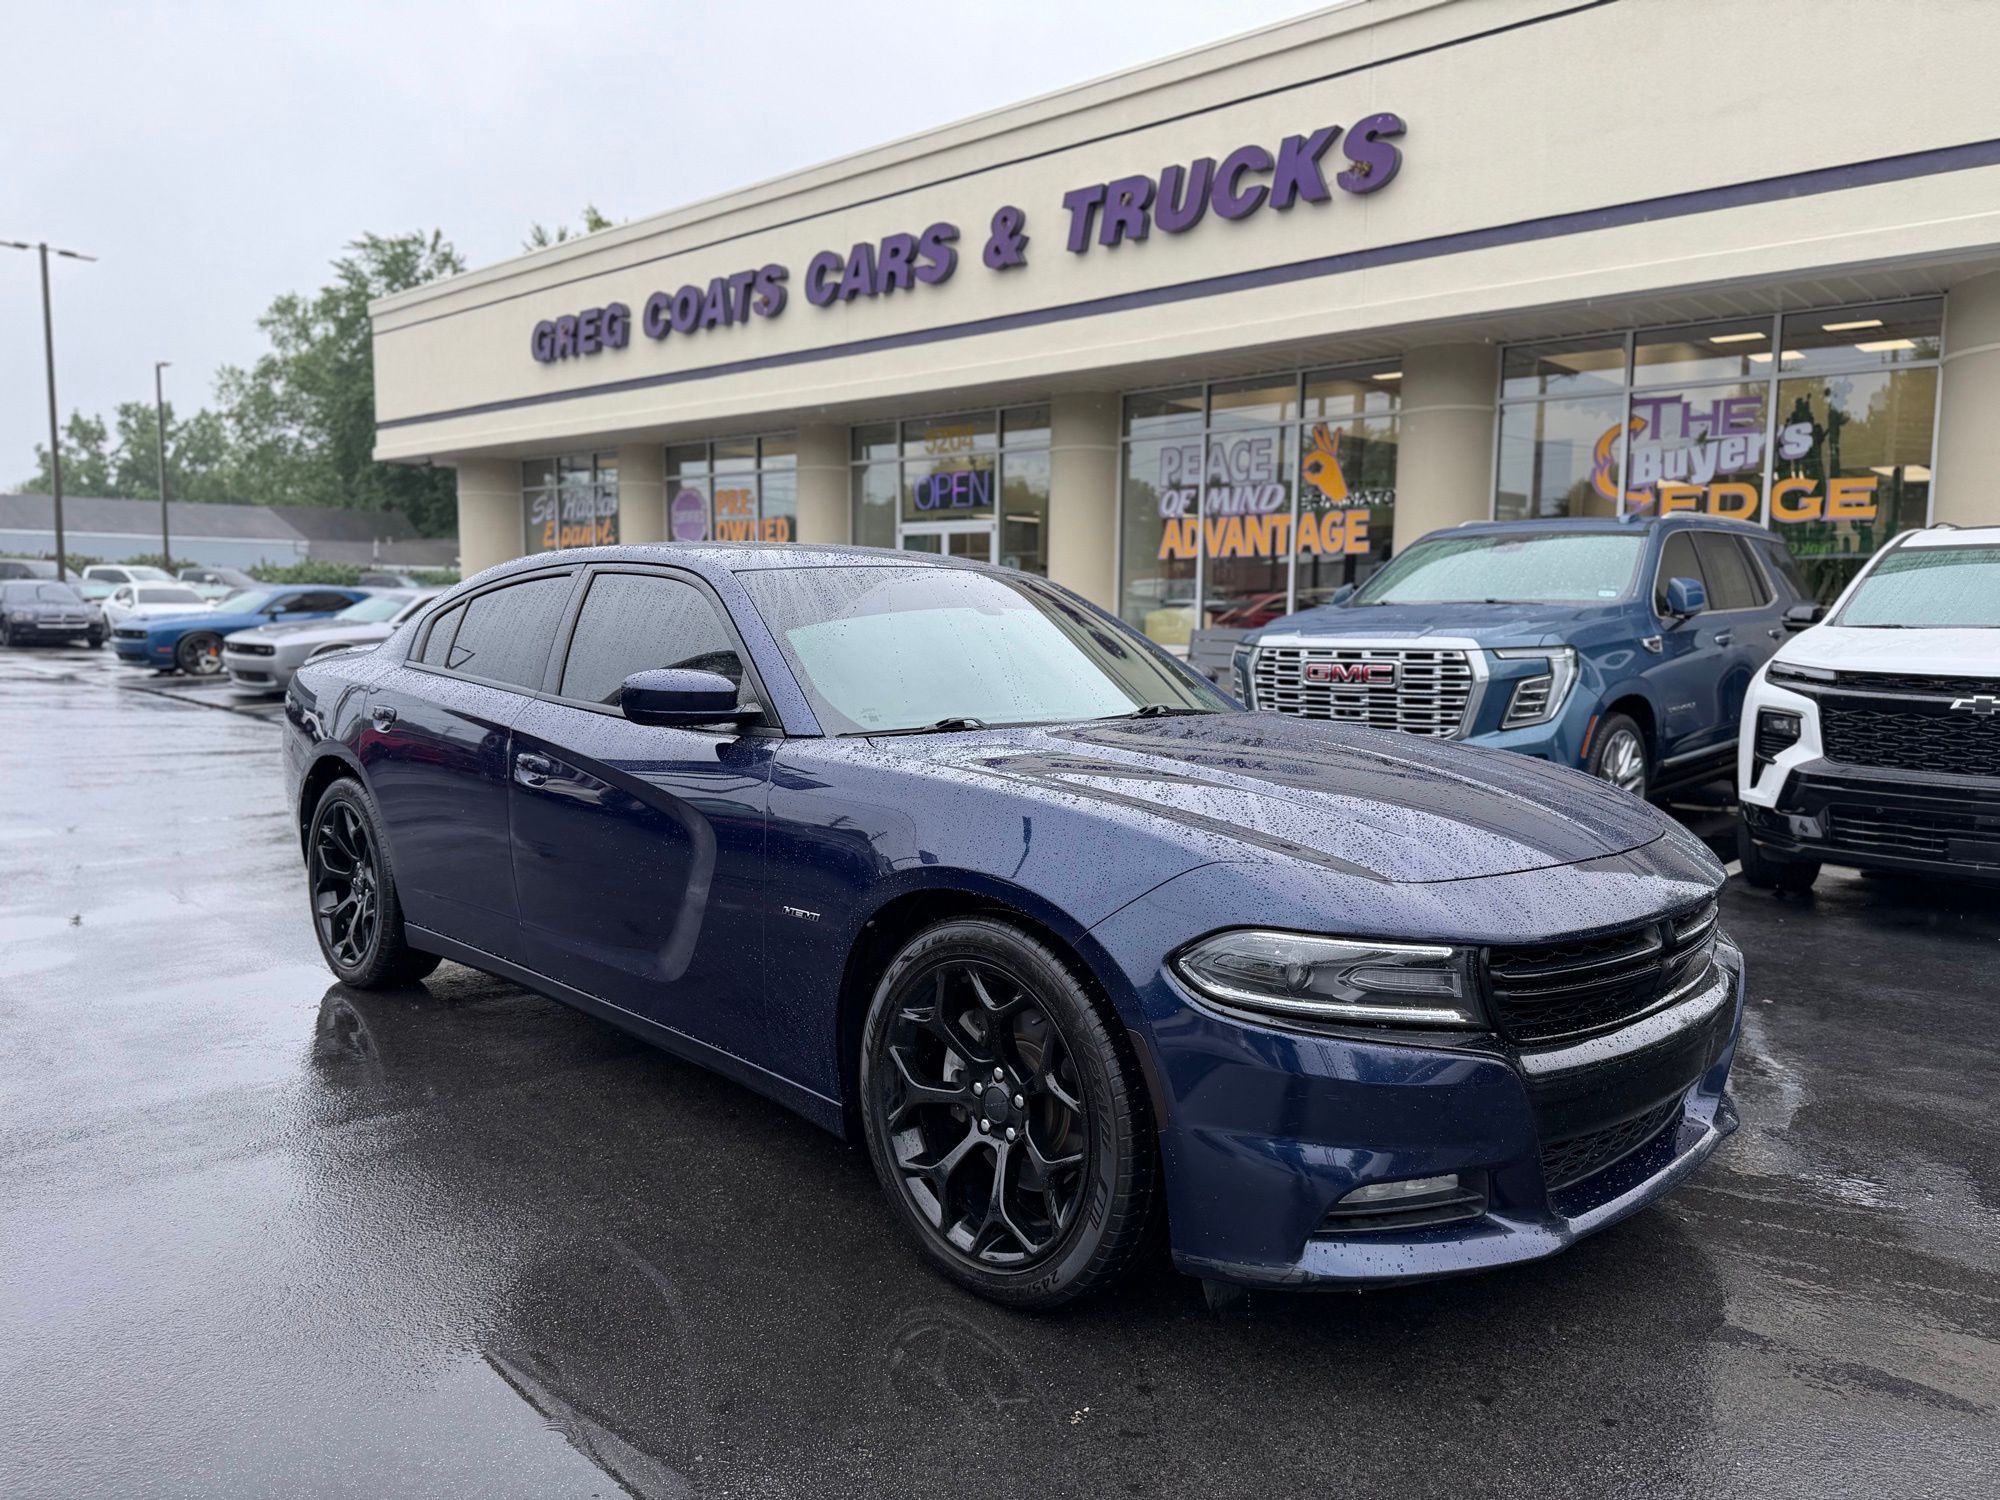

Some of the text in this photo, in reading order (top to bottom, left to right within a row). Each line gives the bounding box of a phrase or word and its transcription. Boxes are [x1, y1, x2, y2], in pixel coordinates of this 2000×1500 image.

[532, 112, 1406, 362] GREG COATS CARS & TRUCKS
[1630, 395, 1762, 440] THE
[1159, 438, 1273, 487] PEACE
[914, 471, 990, 511] OPEN
[1159, 488, 1197, 518] OF
[1205, 483, 1285, 516] MIND
[1660, 475, 1878, 523] EDGE
[715, 516, 790, 543] OWNED
[1157, 509, 1371, 560] ADVANTAGE
[1306, 663, 1393, 683] GMC
[782, 906, 820, 922] HEMI
